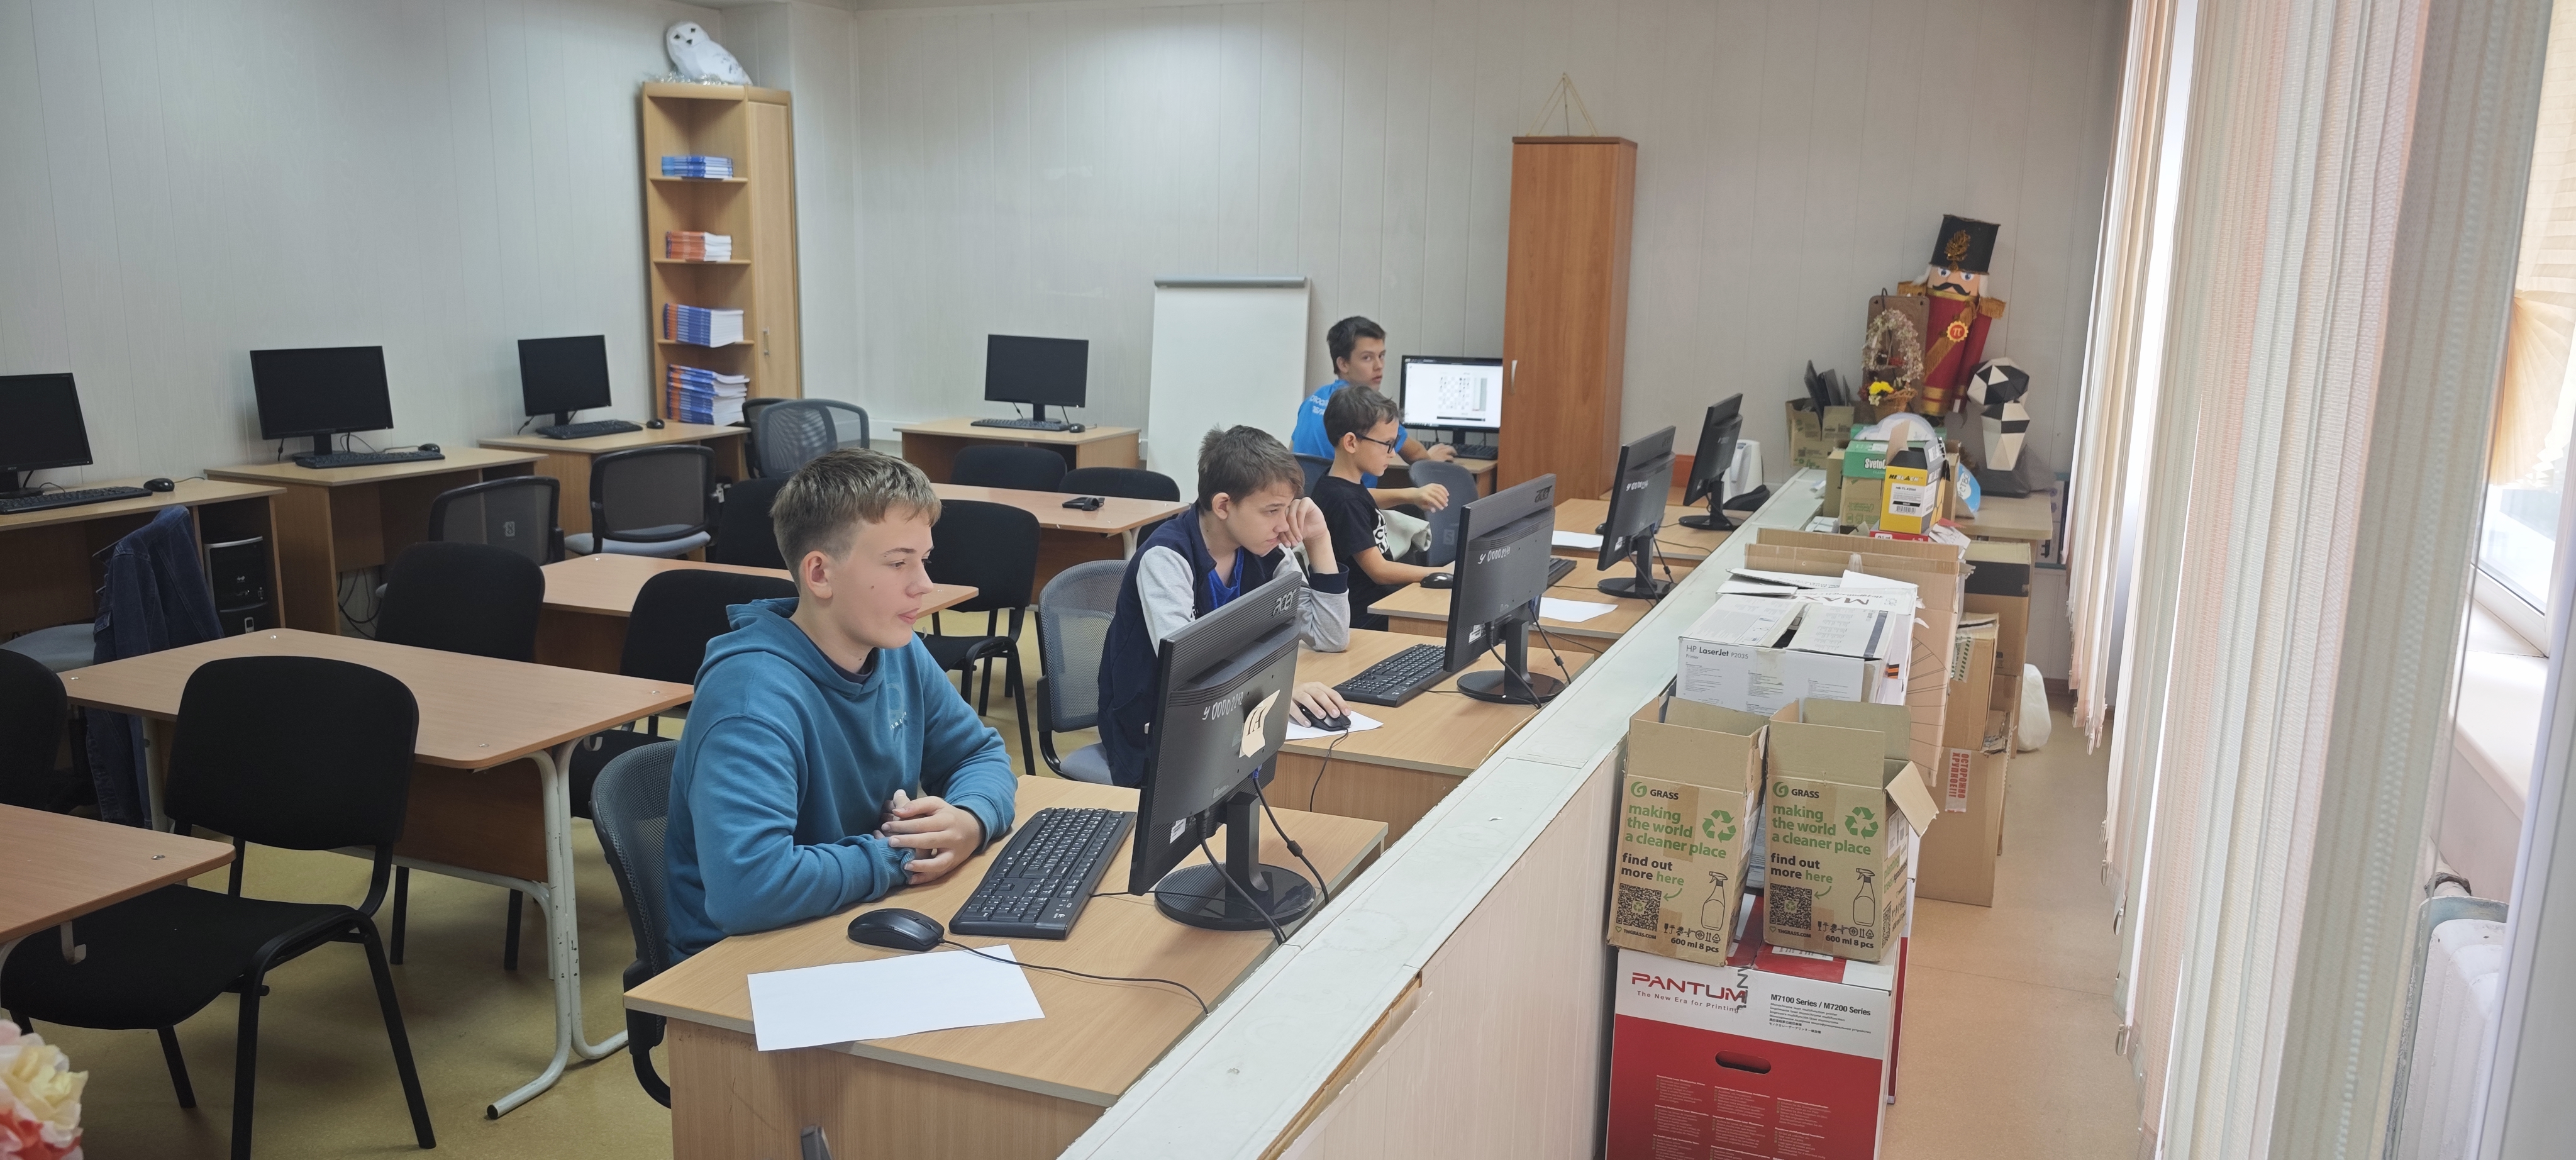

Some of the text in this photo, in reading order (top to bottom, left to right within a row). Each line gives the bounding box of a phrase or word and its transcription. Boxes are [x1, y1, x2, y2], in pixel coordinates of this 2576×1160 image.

[1273, 588, 1297, 616] acer
[1686, 645, 1697, 653] HP
[1699, 647, 1729, 657] LaserJet
[1957, 753, 1969, 799] ОСТОРОЖНО
[1650, 789, 1679, 800] GRASS
[1791, 788, 1819, 799] GRASS
[1629, 805, 1681, 824] making
[1773, 805, 1823, 823] making
[1627, 817, 1693, 839] the world
[1772, 817, 1836, 836] the world
[1625, 832, 1726, 859] a cleaner place
[1772, 832, 1872, 856] a cleaner place
[1622, 852, 1673, 871] find out
[1770, 853, 1820, 869] find out
[1621, 867, 1685, 886] more here
[1770, 867, 1833, 884] more here
[1670, 937, 1685, 946] 600
[1777, 929, 1811, 938] THGRASS.COM
[1825, 935, 1840, 943] 600
[1631, 972, 1747, 1003] PANTUM
[1706, 1002, 1739, 1014] Printing
[1771, 994, 1794, 1003] M7100
[1796, 998, 1817, 1007] Series
[1824, 1003, 1848, 1012] M7200
[1849, 1007, 1871, 1016] Series
